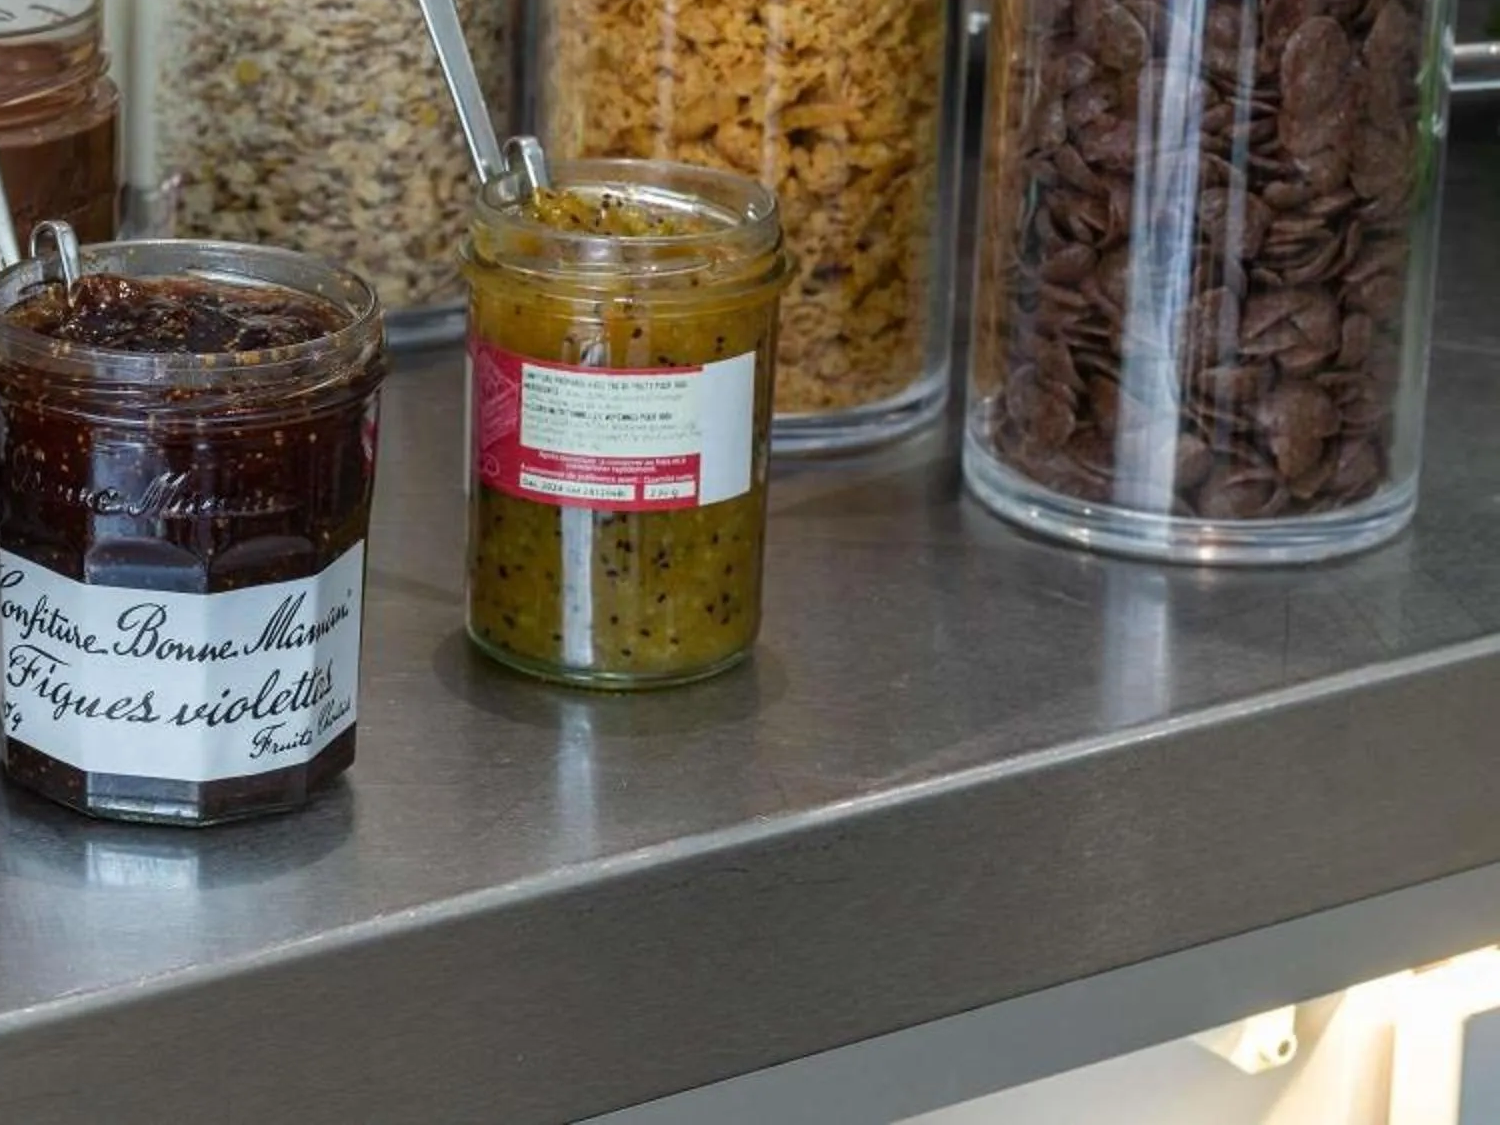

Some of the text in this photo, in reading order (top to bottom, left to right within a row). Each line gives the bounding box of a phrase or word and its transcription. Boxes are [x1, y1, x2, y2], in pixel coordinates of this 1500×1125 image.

[113, 601, 239, 664] Bonne
[243, 590, 350, 656] Maman
[7, 644, 334, 729] Figues violettes
[250, 722, 313, 758] Fruits
